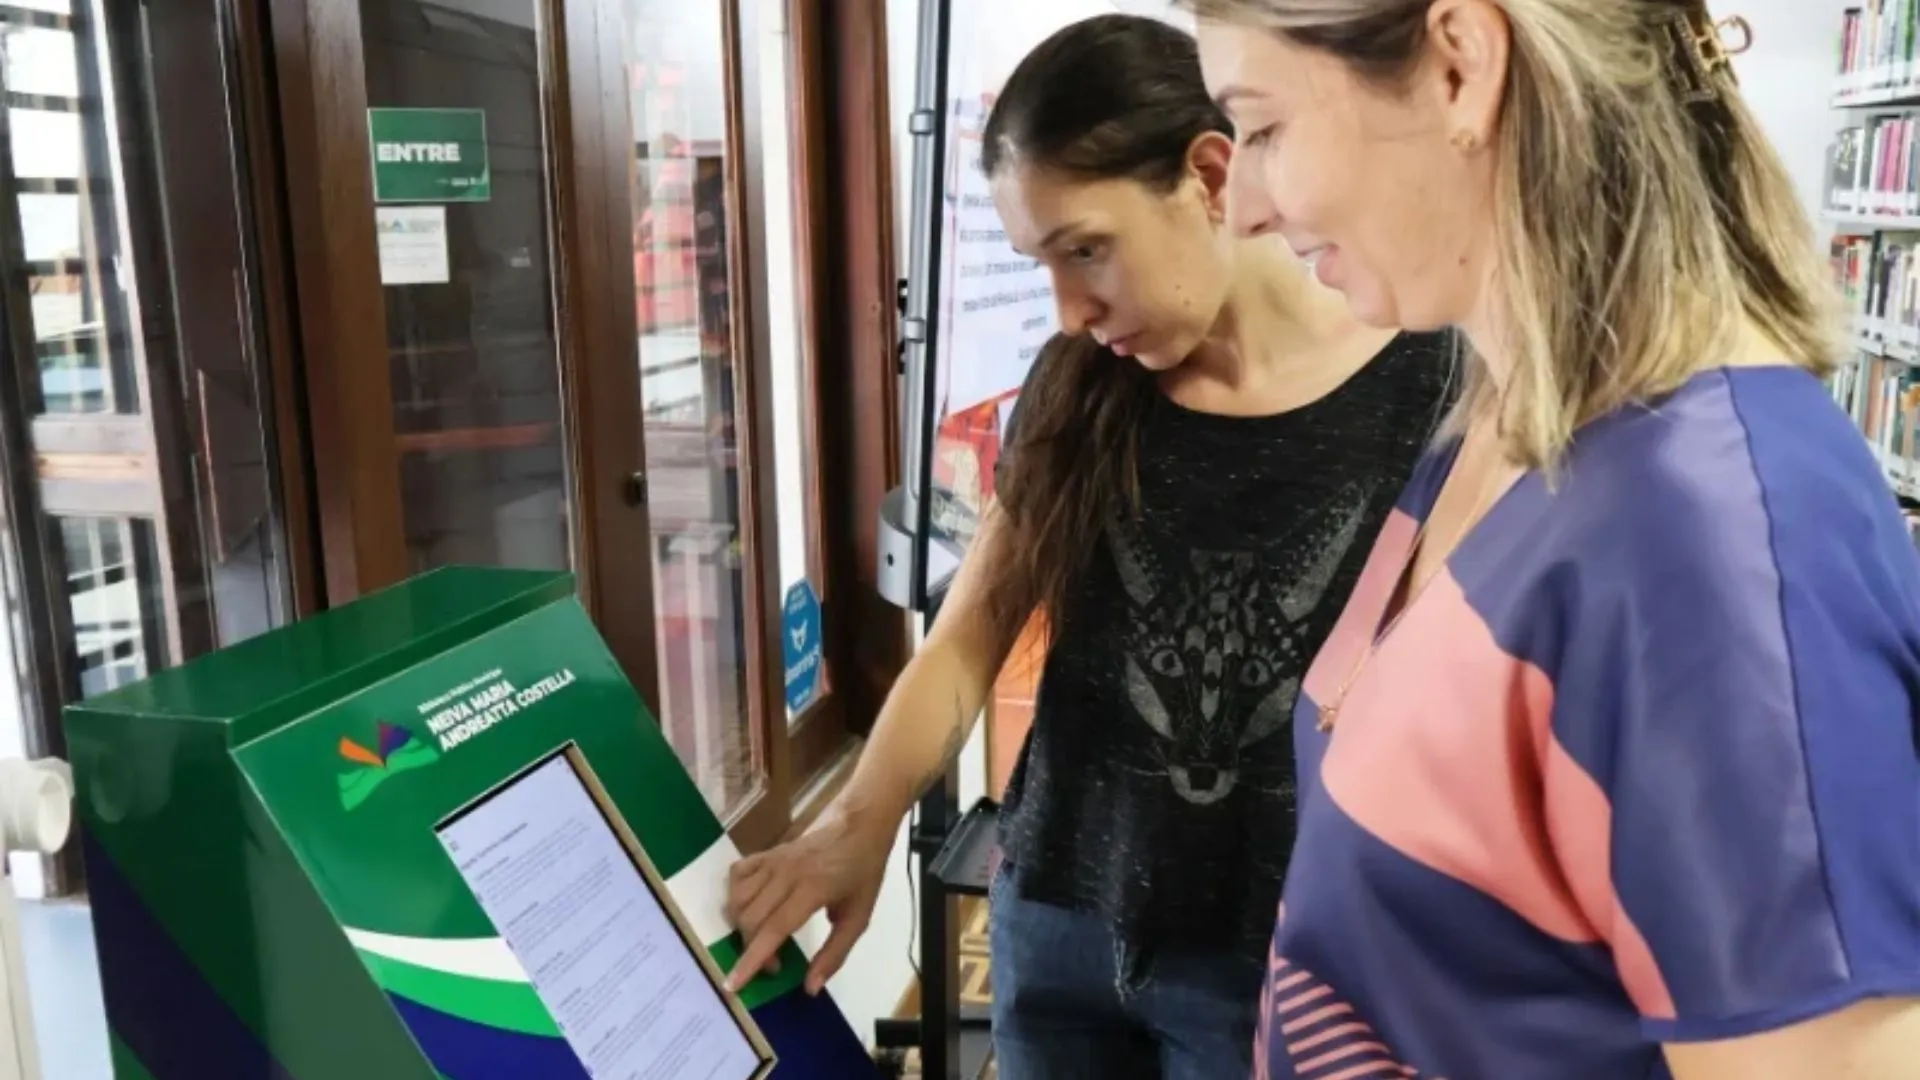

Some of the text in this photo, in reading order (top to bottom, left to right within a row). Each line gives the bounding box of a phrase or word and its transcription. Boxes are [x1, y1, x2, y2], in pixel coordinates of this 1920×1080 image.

[376, 142, 461, 162] ENTRE
[426, 700, 473, 735] NEIVA
[469, 679, 516, 711] MARIA
[438, 699, 519, 752] ANDREATTA
[515, 668, 577, 707] COSTELLA
